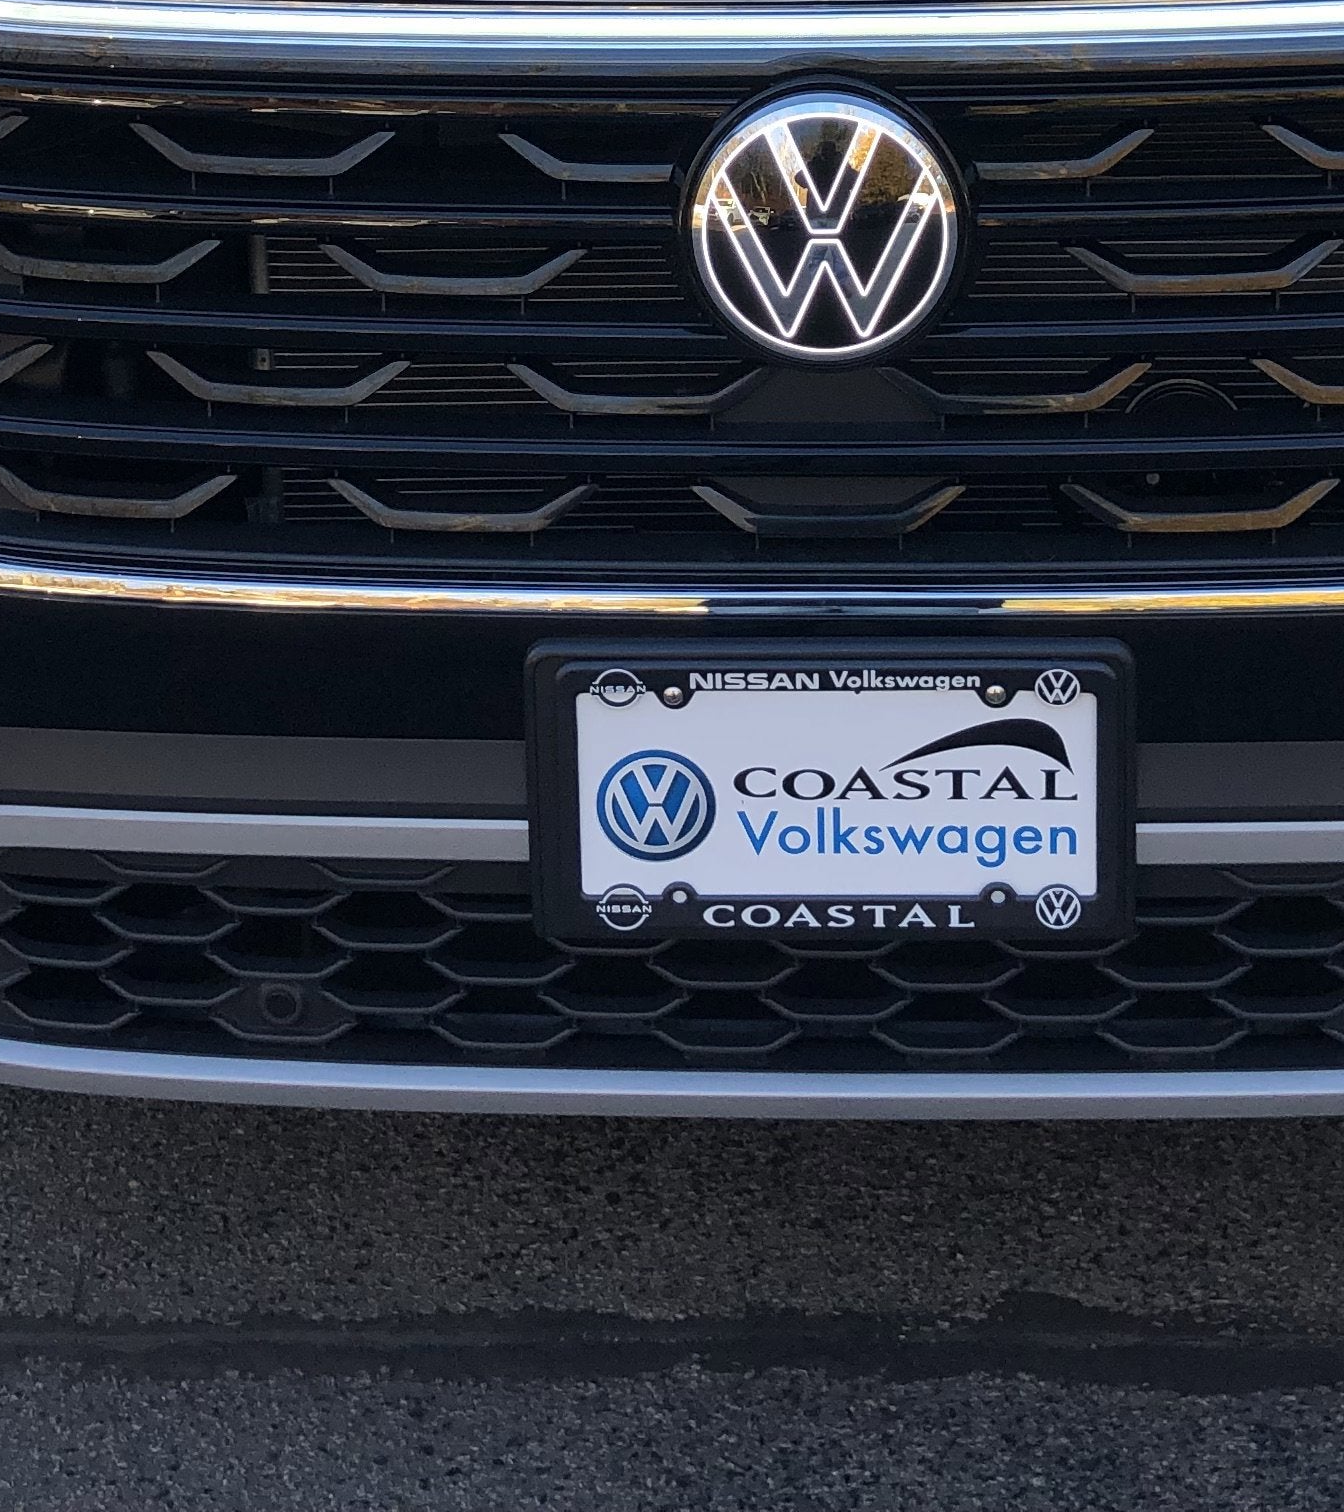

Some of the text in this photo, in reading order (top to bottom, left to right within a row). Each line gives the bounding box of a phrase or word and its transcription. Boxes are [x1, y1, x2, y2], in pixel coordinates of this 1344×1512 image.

[689, 669, 981, 692] NISSAN Volkswagen
[732, 765, 1078, 801] COASTAL
[736, 806, 1078, 868] Volkswagen
[702, 902, 976, 928] COASTAL
